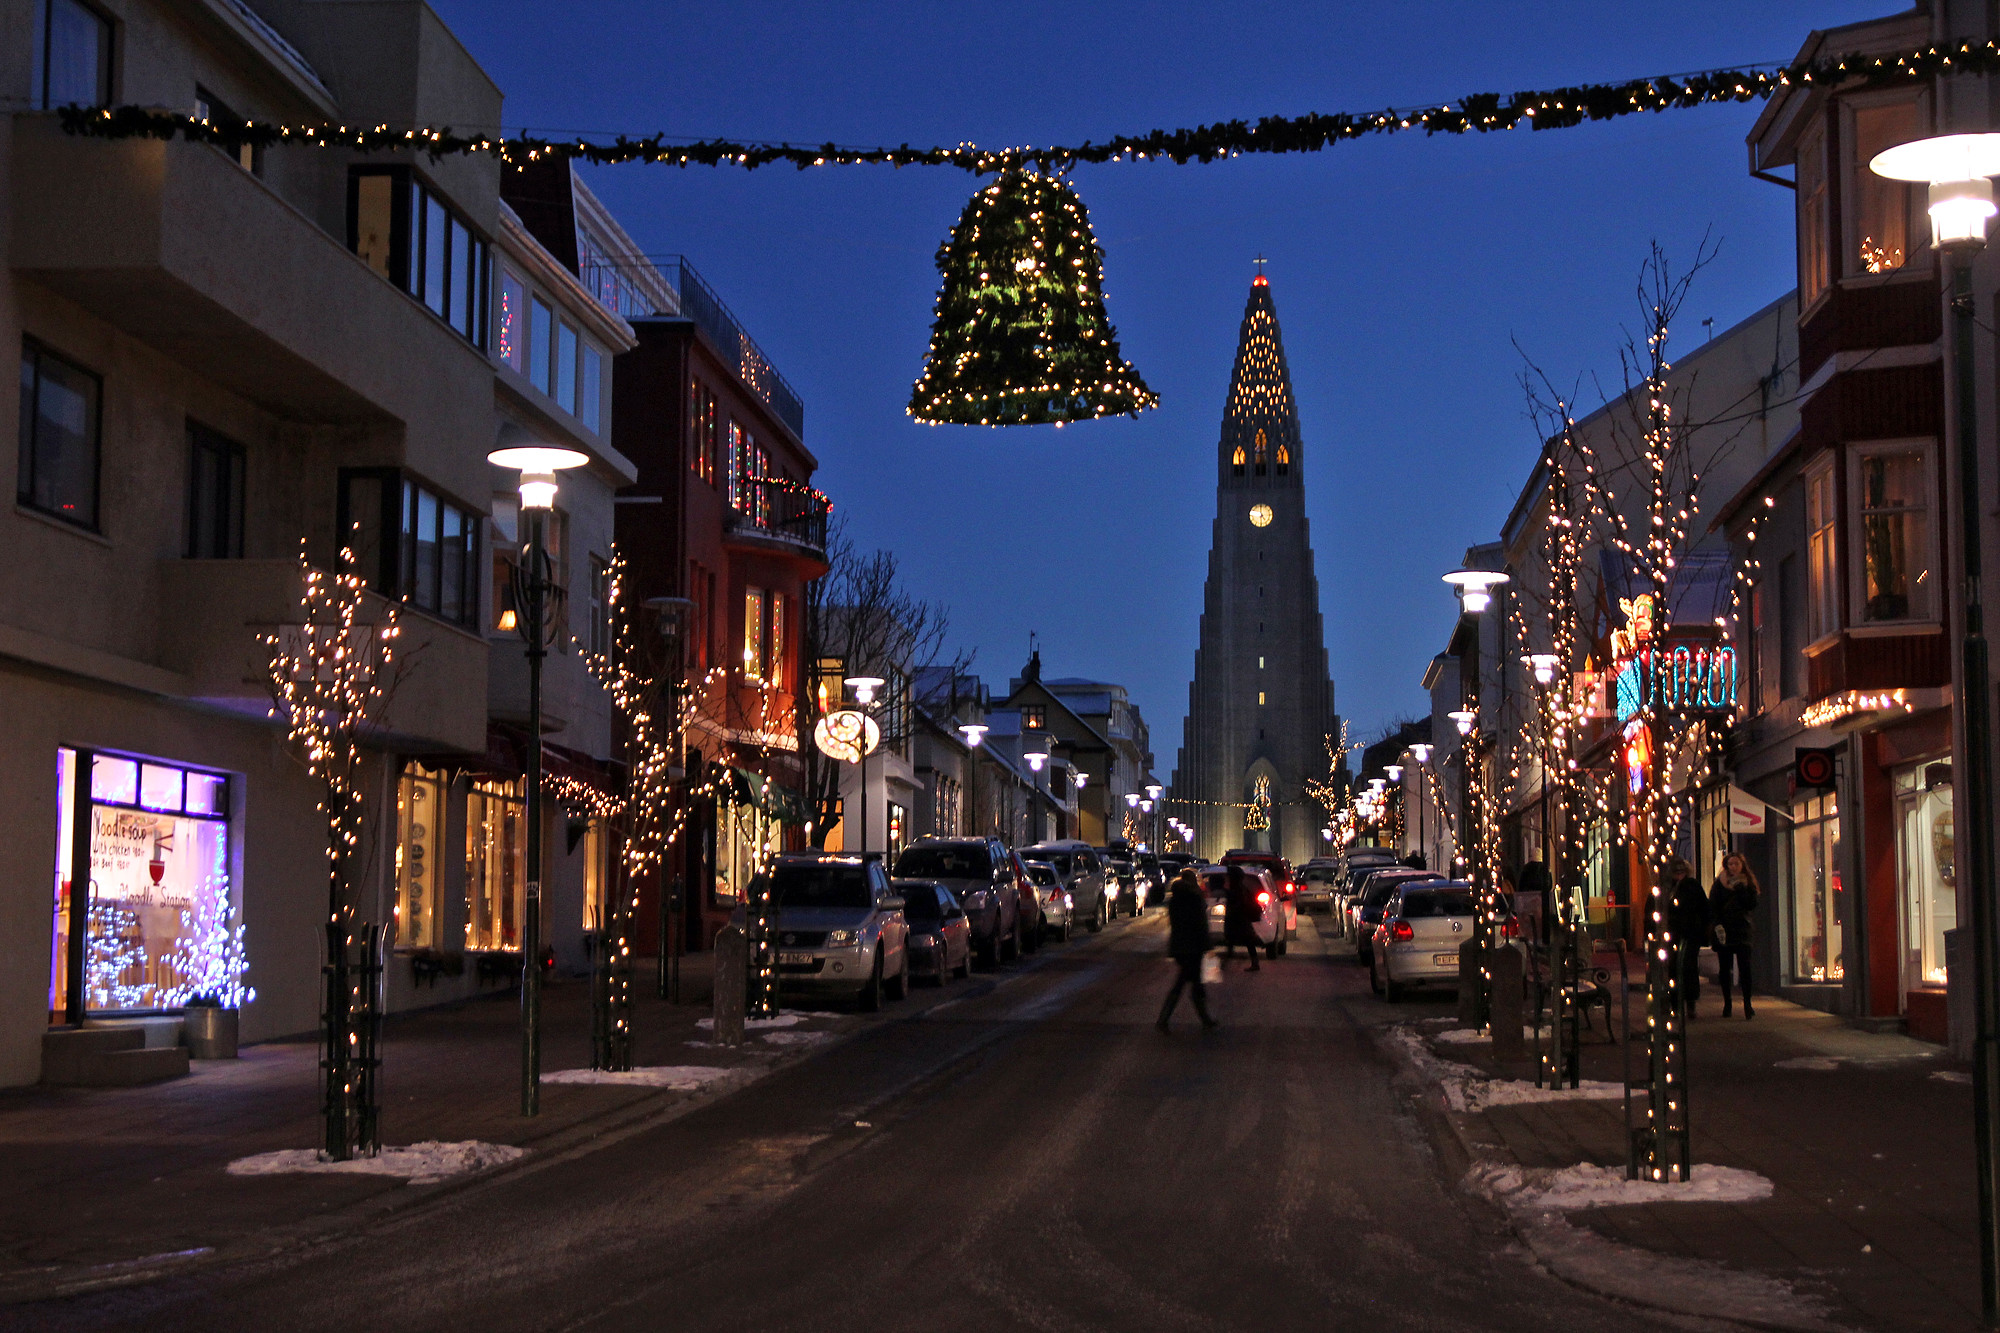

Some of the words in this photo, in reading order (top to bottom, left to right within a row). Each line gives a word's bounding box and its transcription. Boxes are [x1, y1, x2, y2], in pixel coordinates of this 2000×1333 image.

[93, 810, 126, 837] Noodle
[128, 825, 147, 844] soup
[120, 883, 153, 906] Noodle
[160, 886, 191, 908] Station
